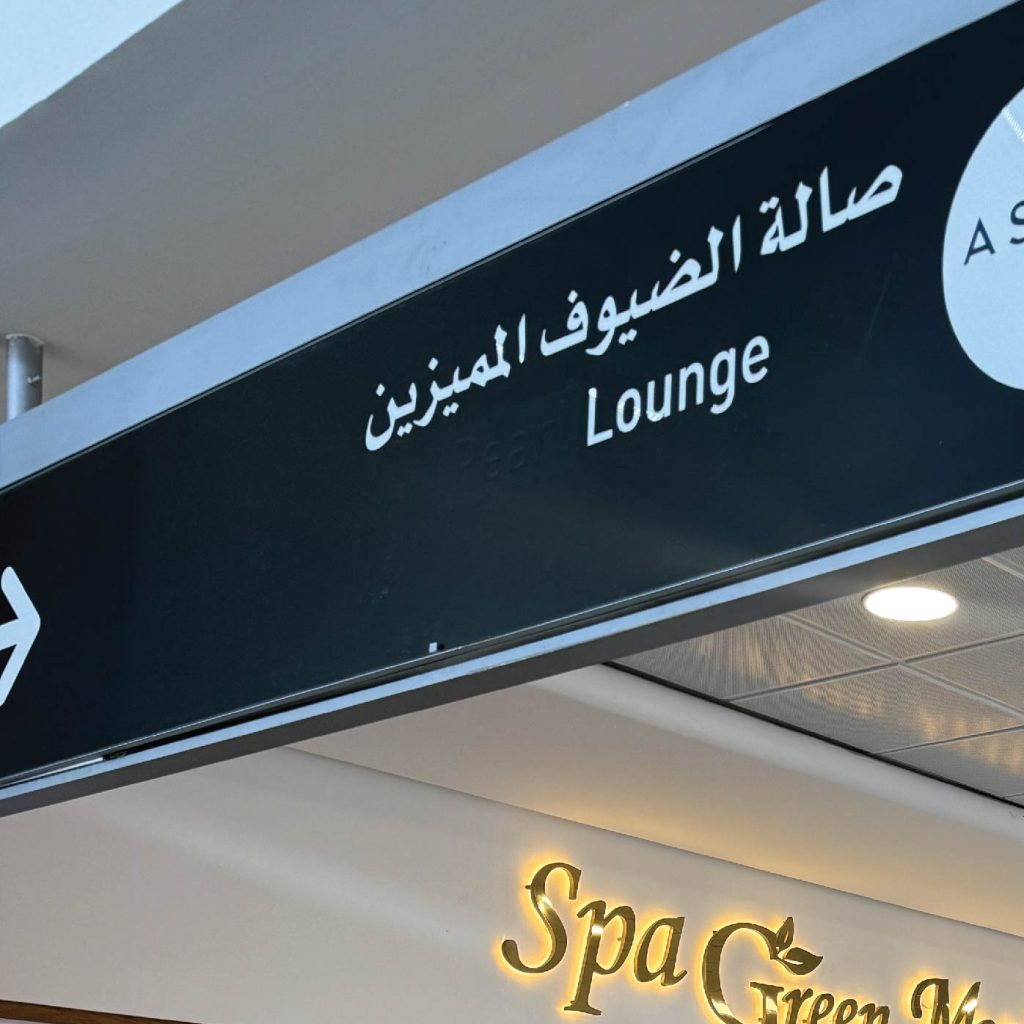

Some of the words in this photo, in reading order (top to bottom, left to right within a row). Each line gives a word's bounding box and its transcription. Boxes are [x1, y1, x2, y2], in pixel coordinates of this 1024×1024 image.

[759, 163, 903, 256] صالة
[539, 214, 741, 356] الضيوف
[364, 313, 527, 451] المميزين
[586, 334, 770, 447] Lounge
[501, 862, 689, 1017] Spa
